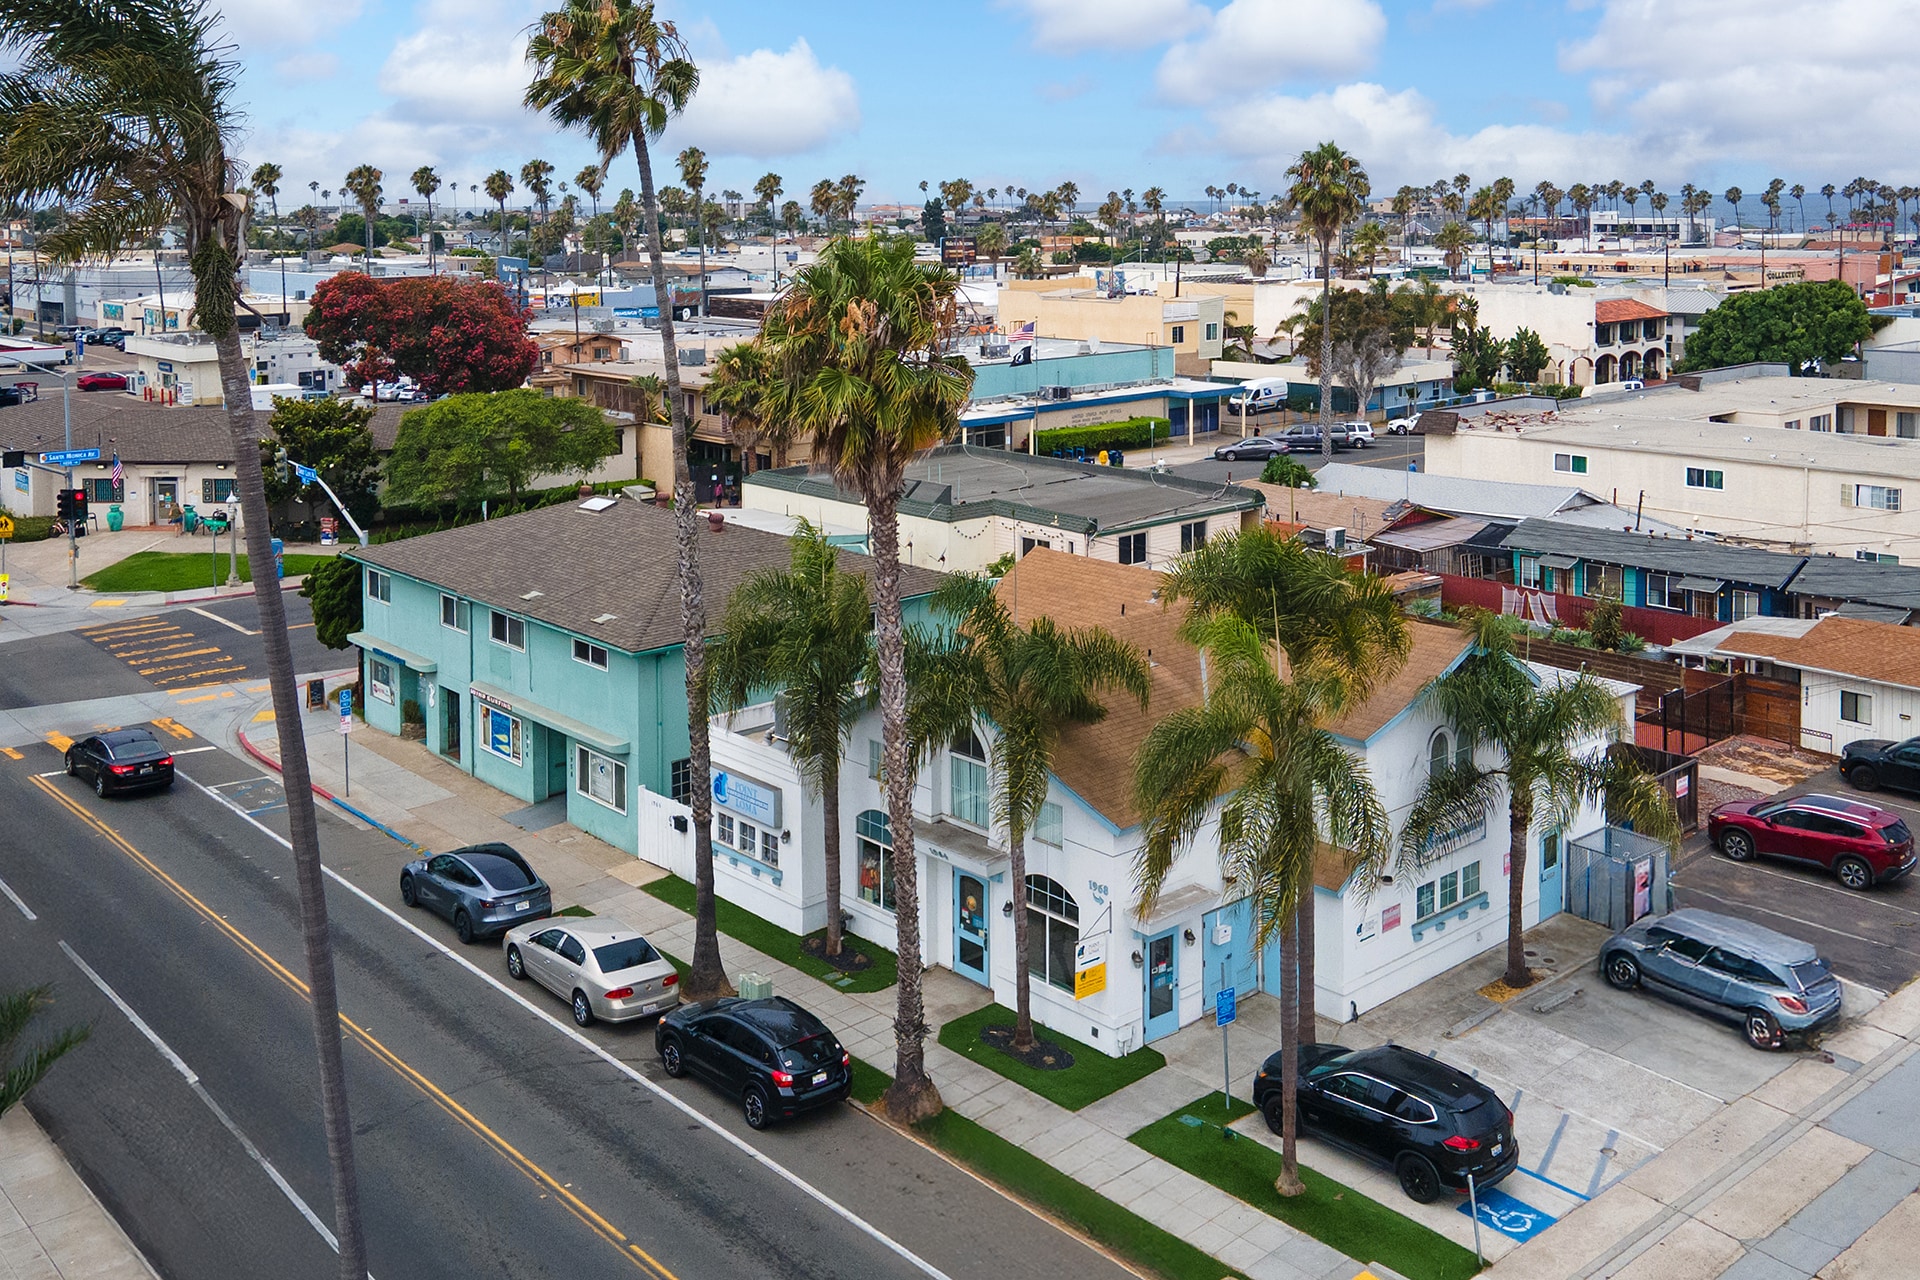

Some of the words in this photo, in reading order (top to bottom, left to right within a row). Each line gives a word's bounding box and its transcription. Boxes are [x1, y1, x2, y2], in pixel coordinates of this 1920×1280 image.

[735, 782, 758, 798] POINT
[735, 799, 758, 816] LOMA
[1088, 880, 1109, 896] 1968
